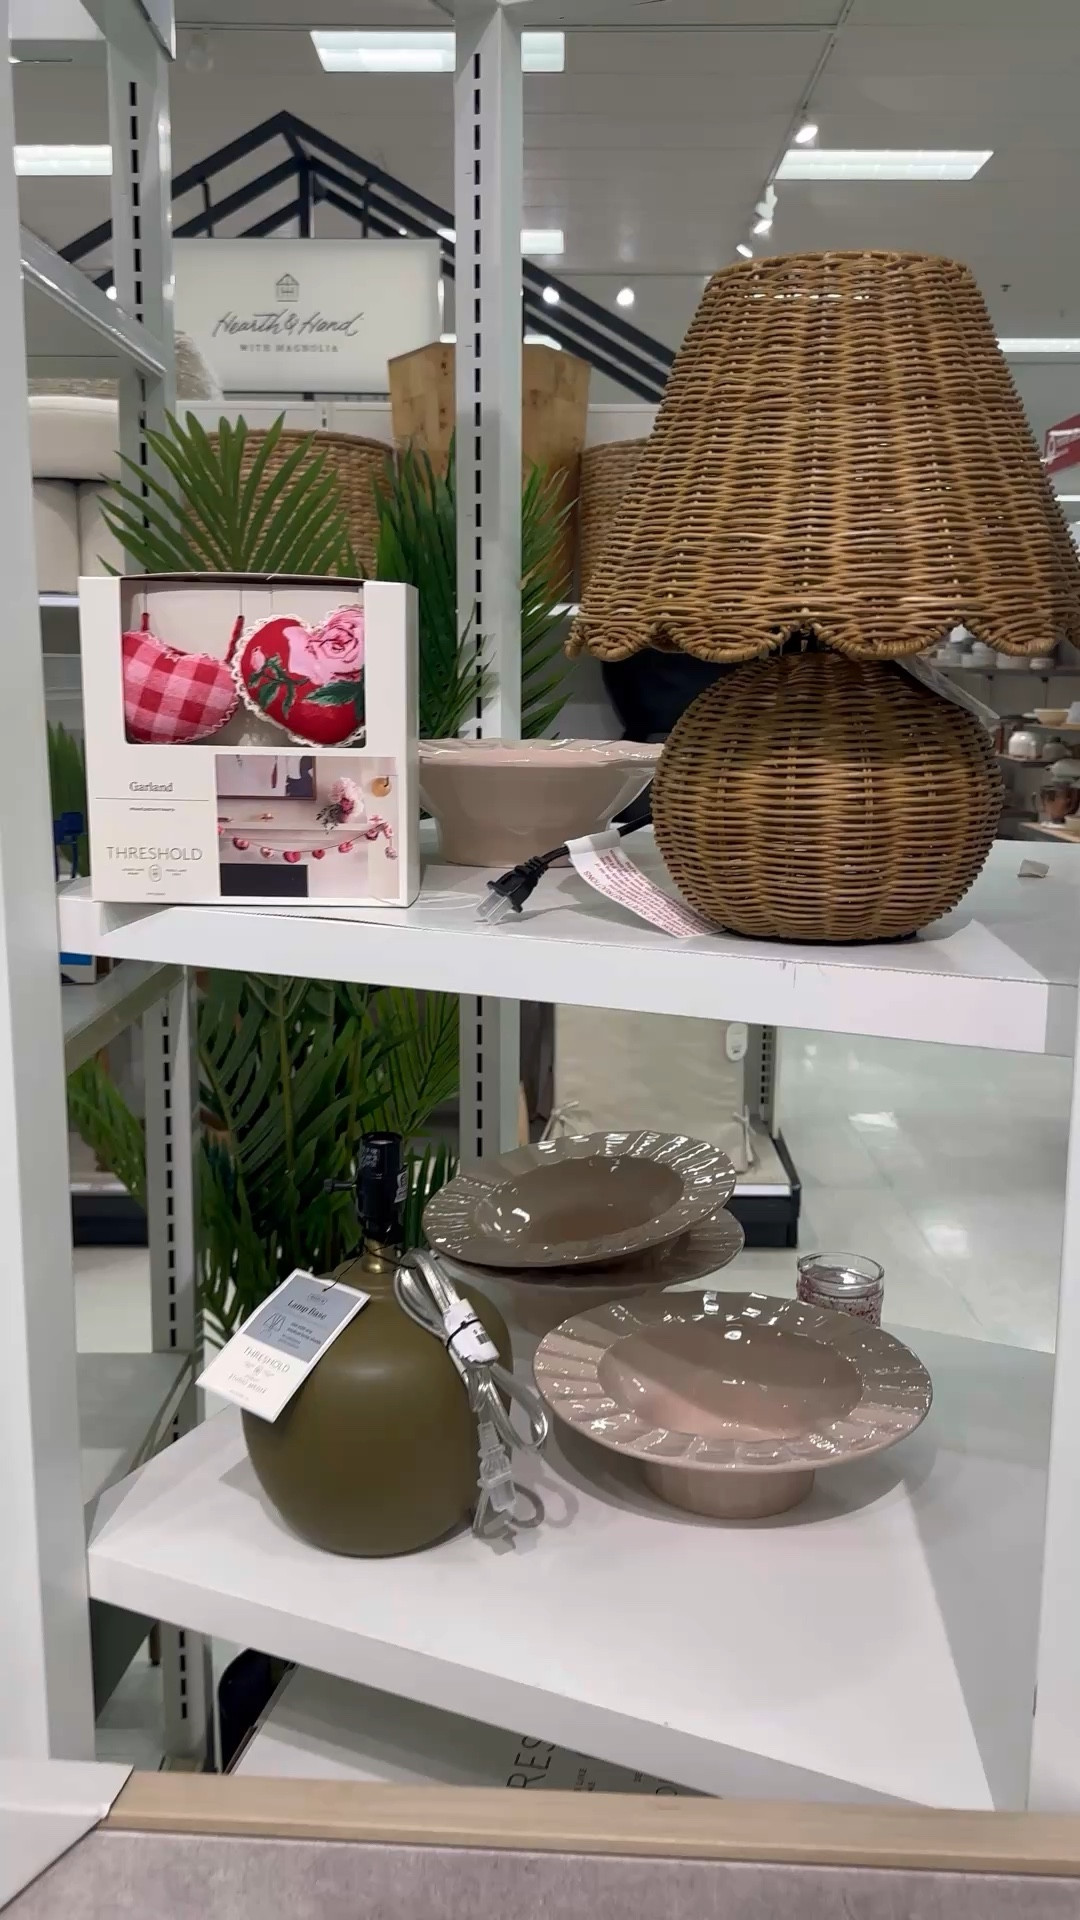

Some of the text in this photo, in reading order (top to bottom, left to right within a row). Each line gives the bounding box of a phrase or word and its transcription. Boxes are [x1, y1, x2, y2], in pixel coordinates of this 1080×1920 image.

[212, 309, 364, 337] Hearth & Hand
[240, 344, 338, 352] WITH MAGNOLIA
[129, 781, 173, 792] Garland
[106, 846, 203, 861] THRESHOLD
[287, 1299, 327, 1320] Lamp Base
